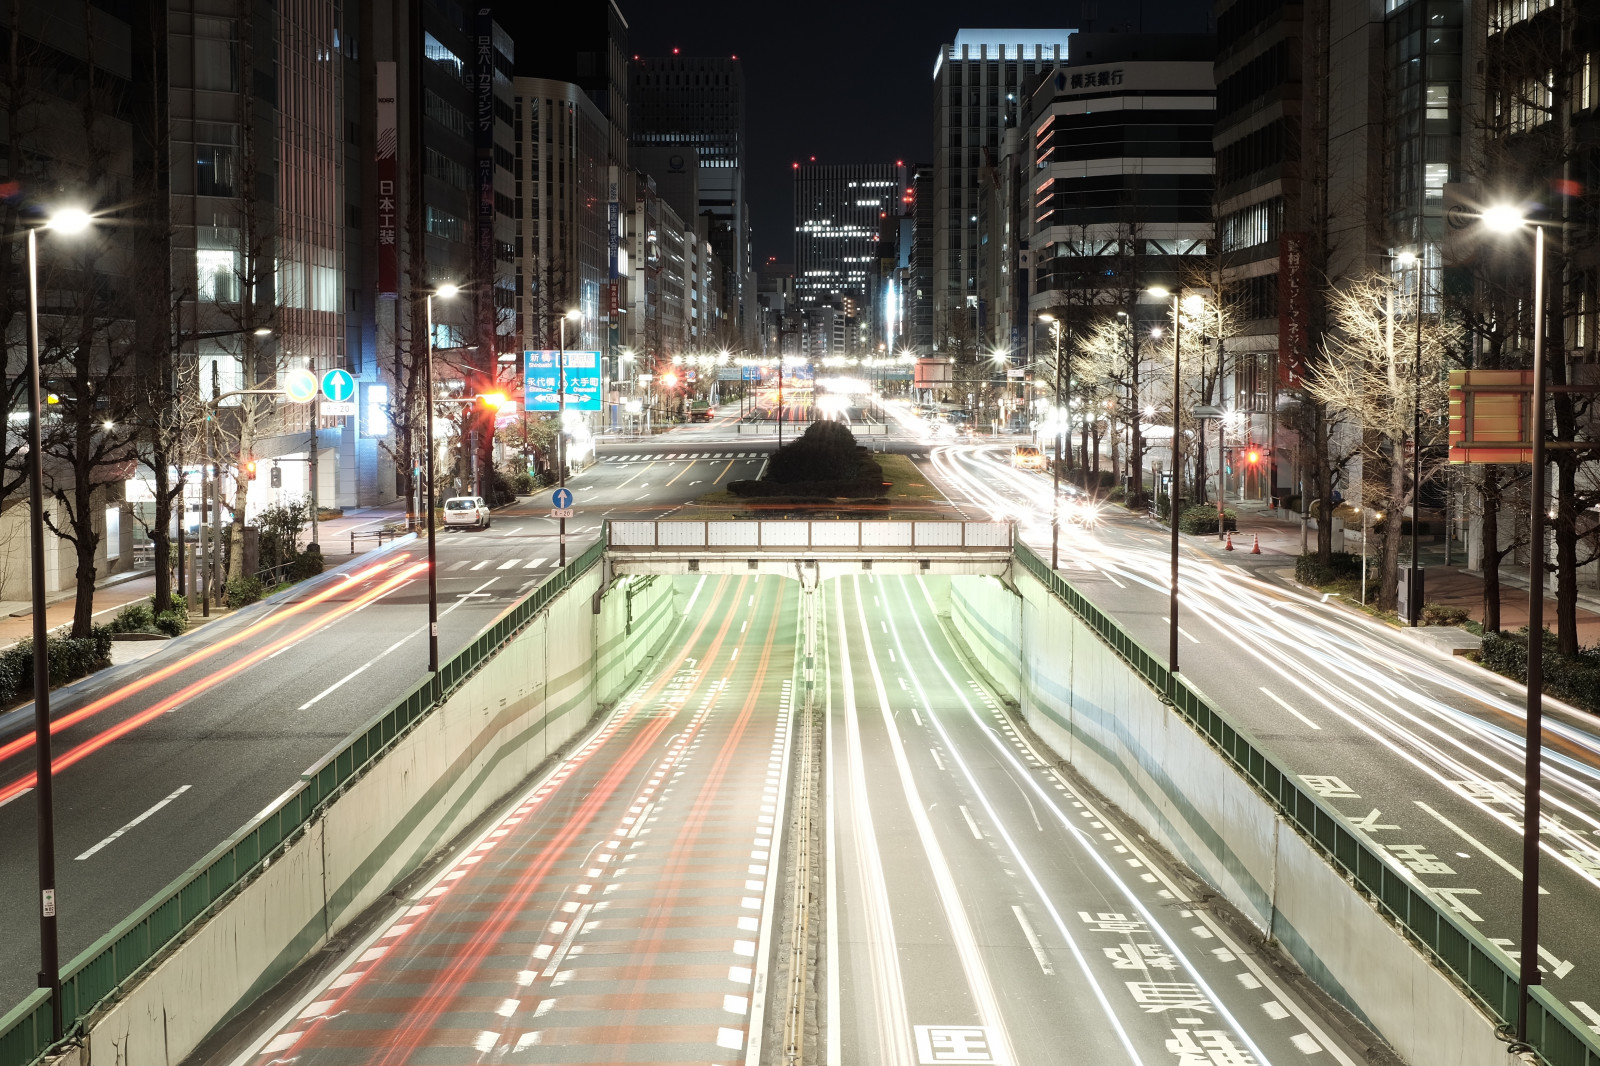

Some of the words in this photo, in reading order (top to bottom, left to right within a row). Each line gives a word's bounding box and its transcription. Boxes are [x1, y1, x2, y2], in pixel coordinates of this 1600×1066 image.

[477, 35, 492, 131] 日本パーカライジング
[1070, 69, 1125, 90] 横浜銀行
[379, 180, 396, 246] 日本工装
[527, 377, 555, 387] 永代橋
[570, 377, 599, 387] 大手町
